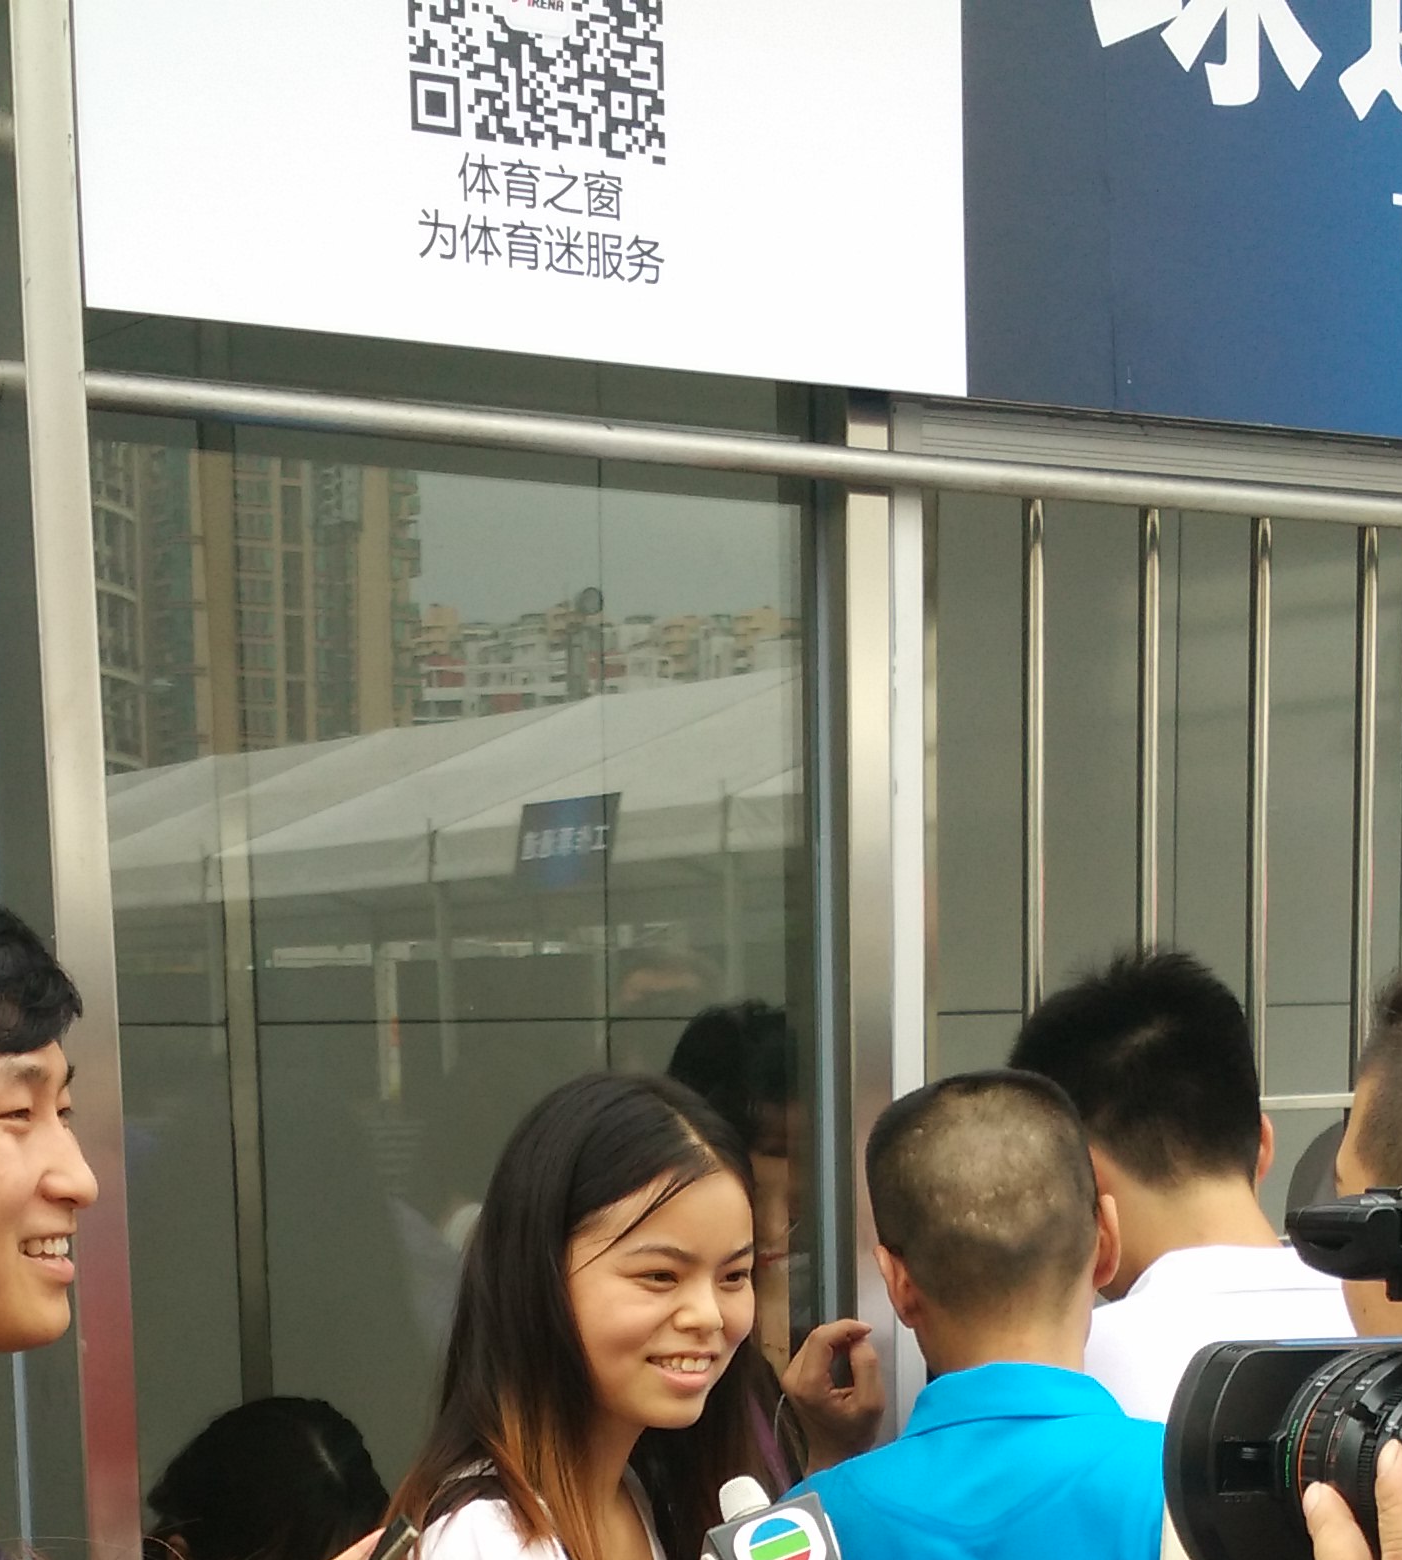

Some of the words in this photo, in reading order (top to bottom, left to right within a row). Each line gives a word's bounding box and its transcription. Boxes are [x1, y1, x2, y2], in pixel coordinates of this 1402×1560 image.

[458, 152, 624, 221] 体育之窗
[418, 208, 665, 285] 为体育迷服务
